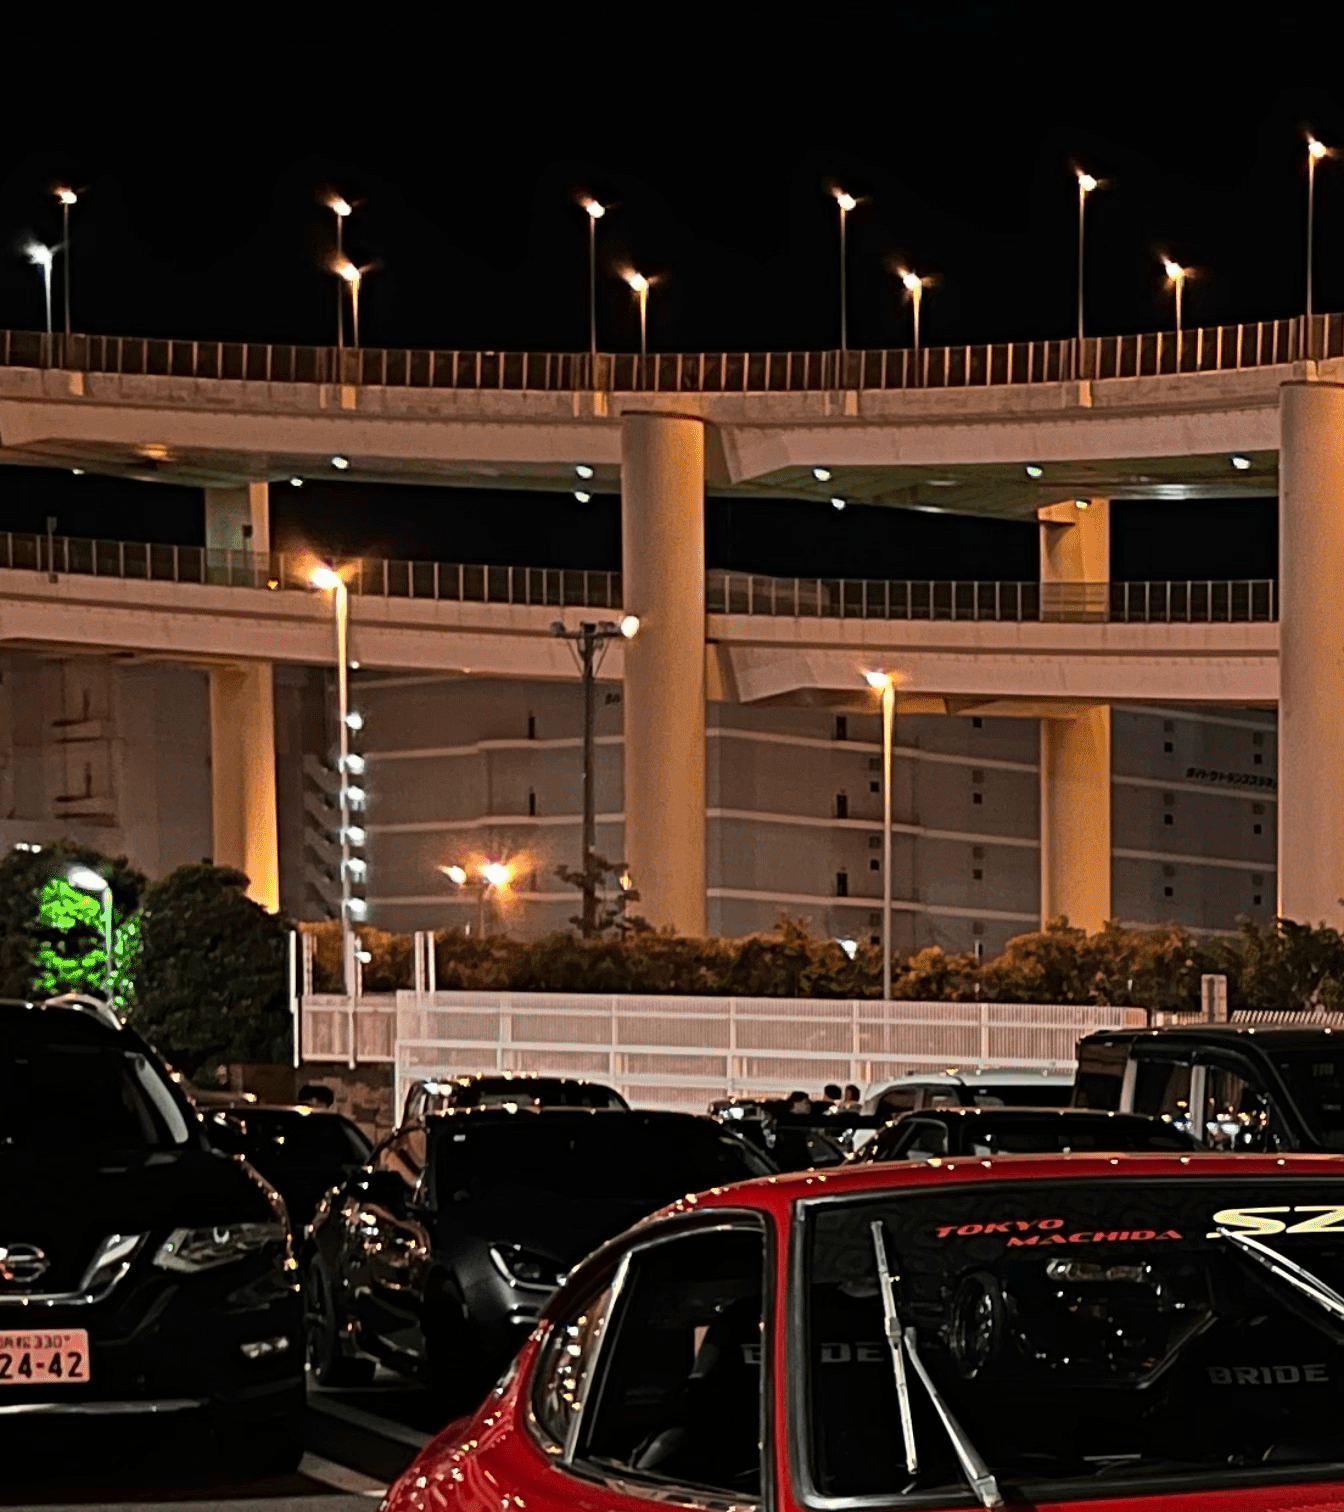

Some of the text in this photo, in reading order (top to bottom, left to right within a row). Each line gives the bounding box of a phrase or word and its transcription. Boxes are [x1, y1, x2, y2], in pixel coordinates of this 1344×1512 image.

[936, 1219, 1064, 1238] TOKYO
[1006, 1229, 1183, 1247] MACHIDA
[0, 1352, 83, 1379] 24-42
[1206, 1363, 1329, 1385] BRIDE
